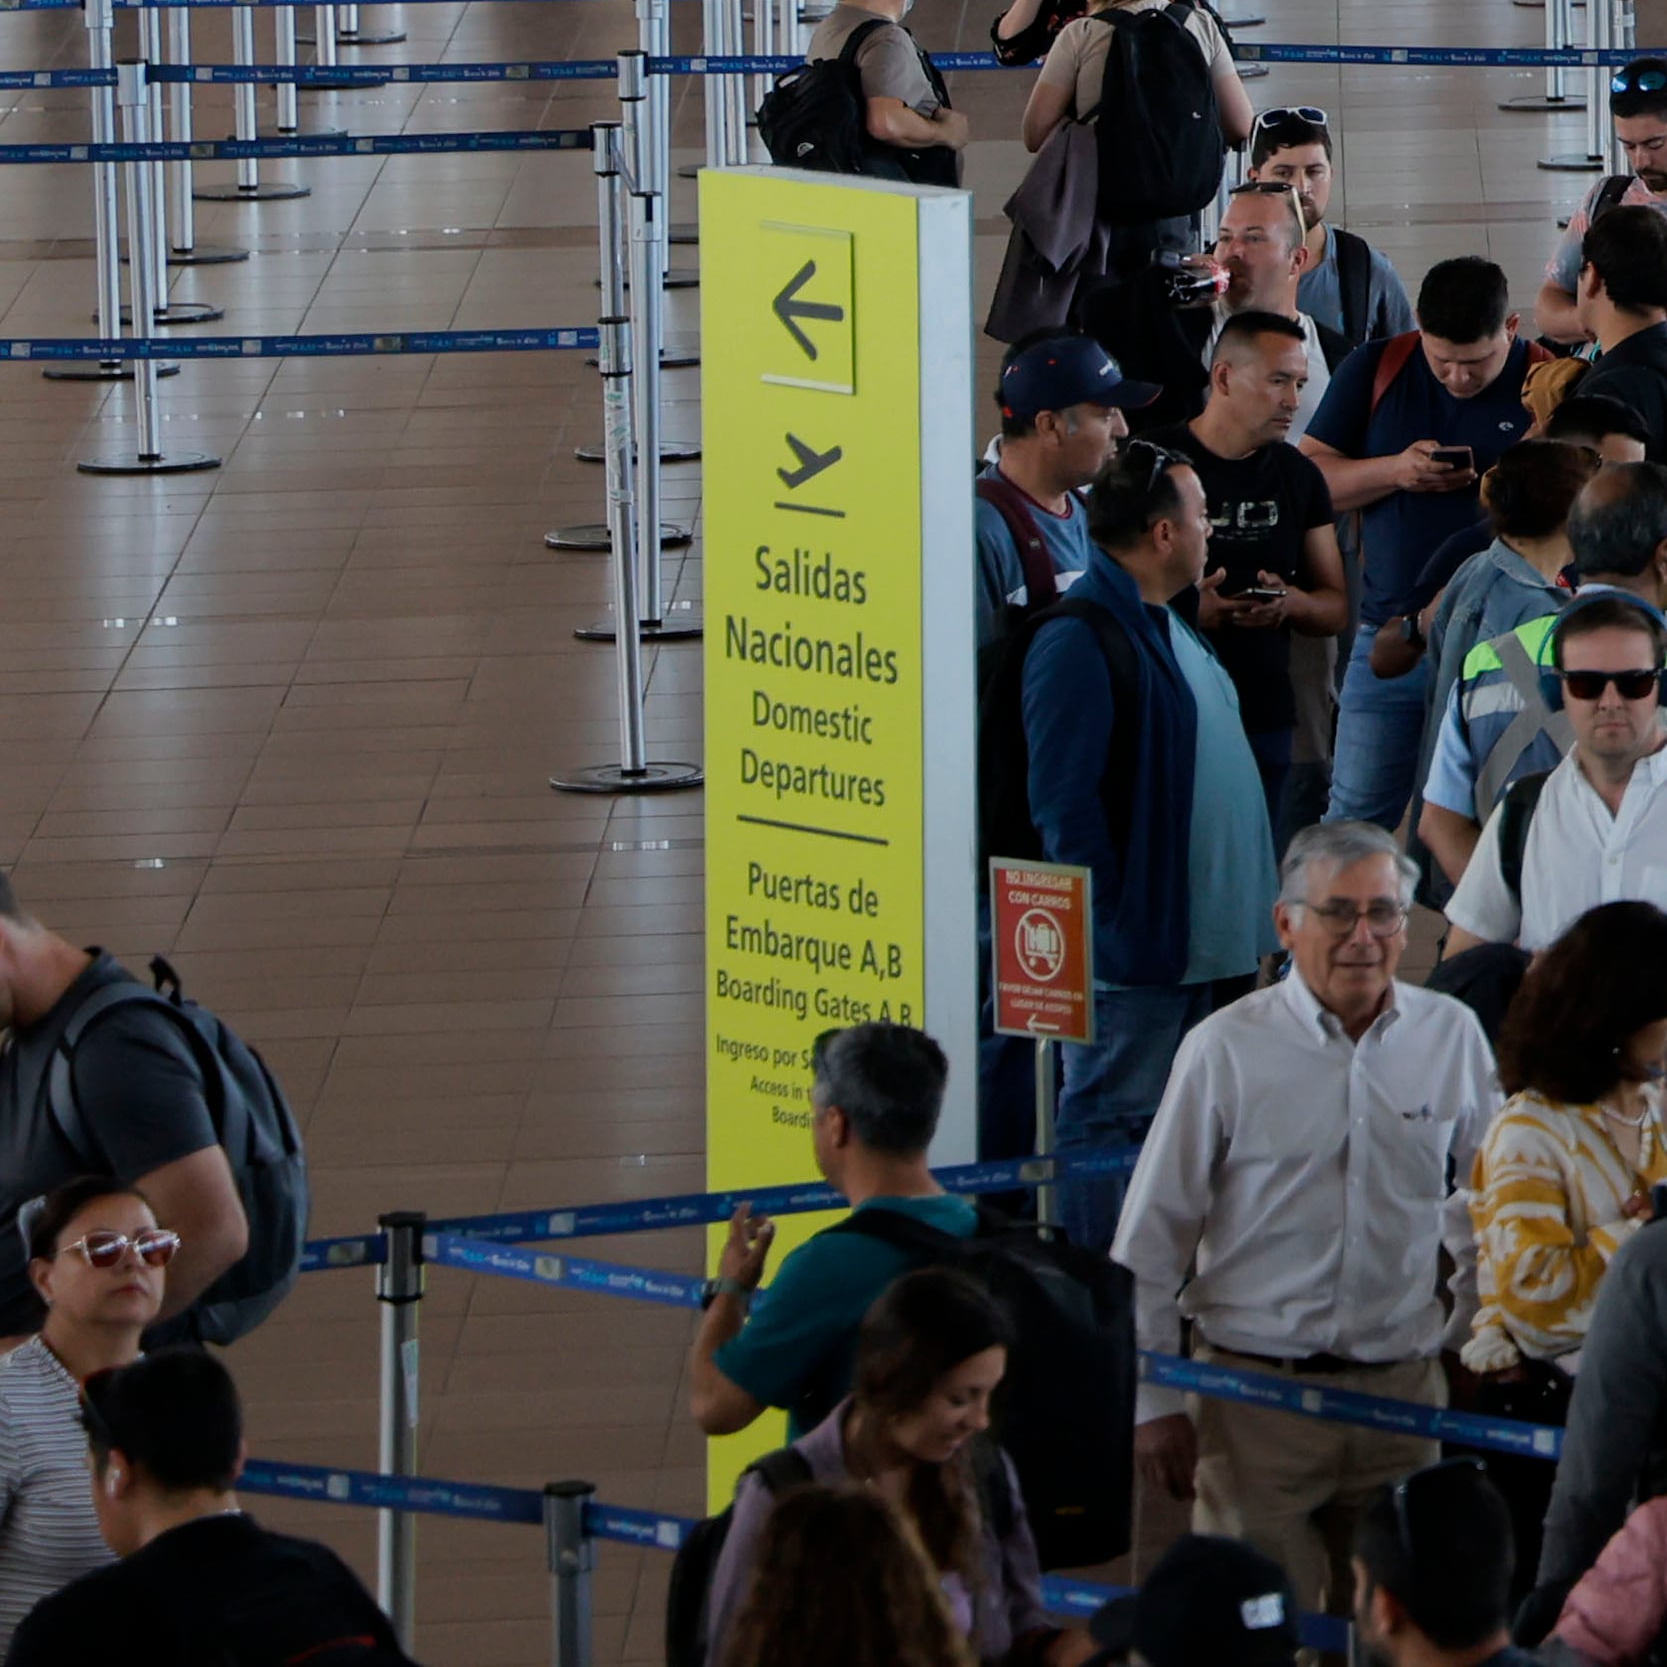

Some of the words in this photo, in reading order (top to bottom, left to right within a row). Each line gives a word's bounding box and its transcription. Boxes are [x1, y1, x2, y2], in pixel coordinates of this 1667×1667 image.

[755, 545, 867, 604] Salidas
[725, 614, 898, 685] Nacionales
[752, 690, 873, 745] Domestic
[741, 748, 886, 807] Departures
[748, 862, 841, 911] Puertas
[848, 878, 879, 918] de
[1022, 872, 1073, 890] INGRESAR
[725, 914, 851, 975] Embarque
[859, 939, 902, 982] A,B
[716, 969, 807, 1021] Boarding
[814, 987, 871, 1024] Gates
[716, 1034, 769, 1062] Ingreso
[772, 1048, 798, 1069] por
[750, 1076, 789, 1098] Access
[791, 1085, 803, 1101] in
